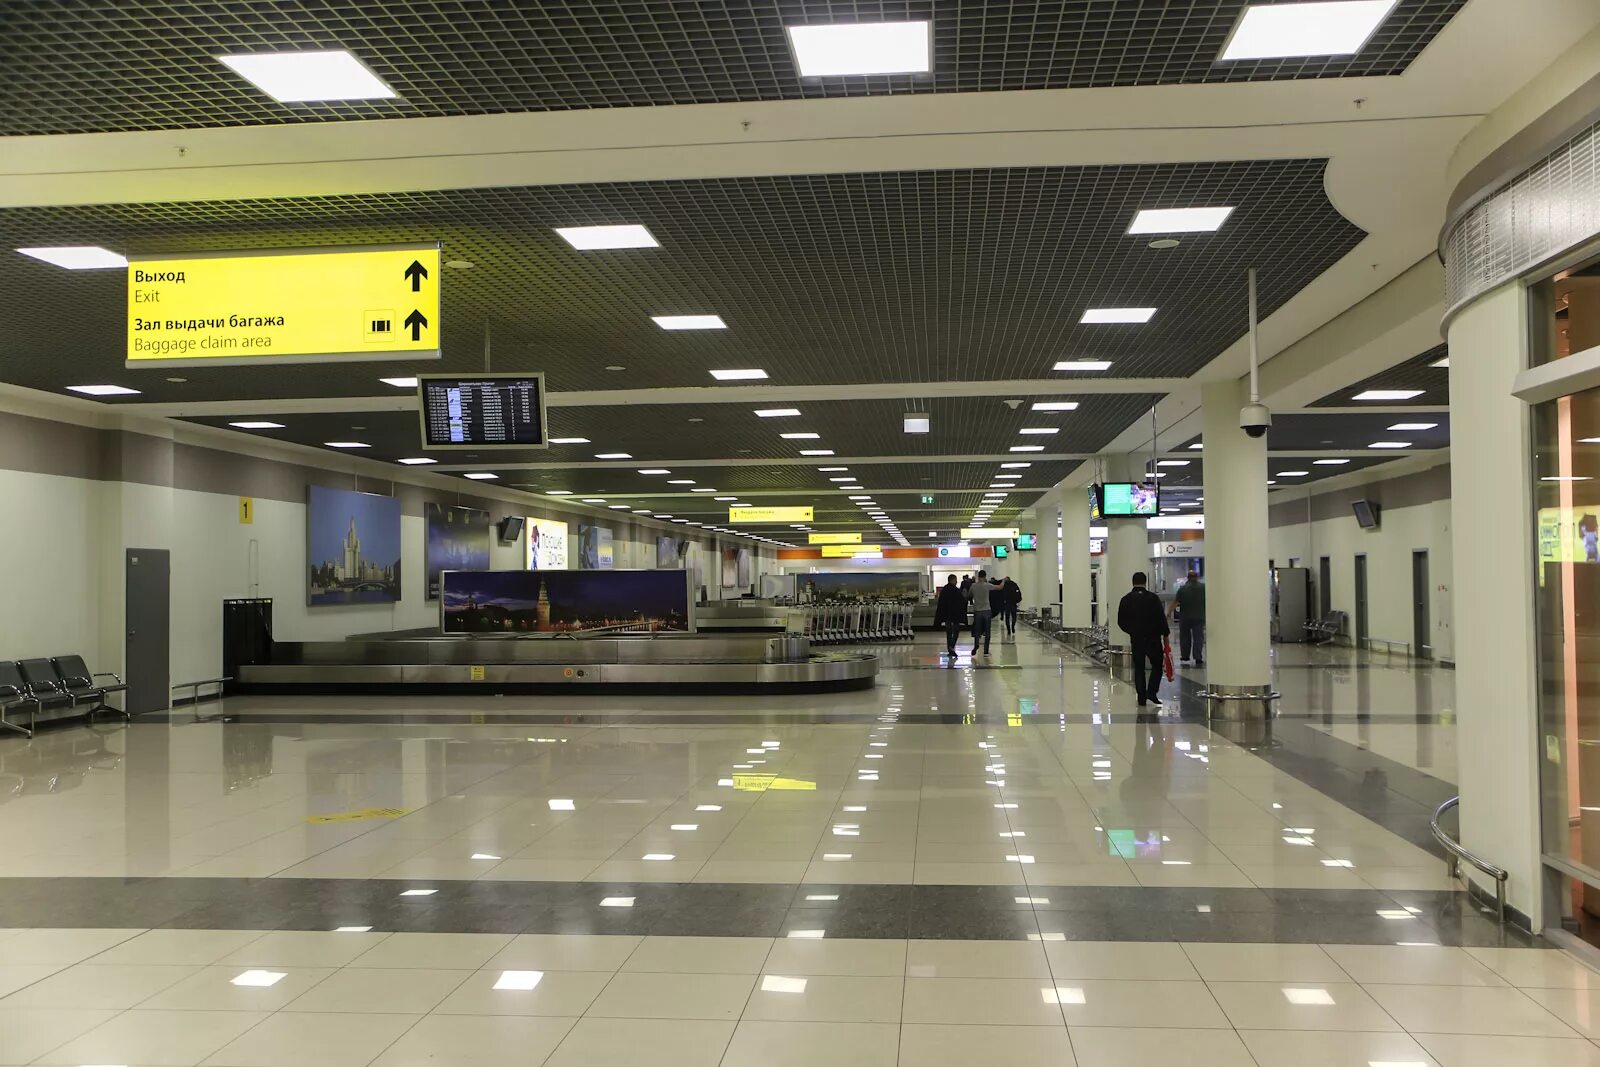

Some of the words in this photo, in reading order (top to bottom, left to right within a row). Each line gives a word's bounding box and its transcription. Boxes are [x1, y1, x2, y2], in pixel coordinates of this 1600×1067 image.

[135, 270, 186, 284] Выход
[135, 289, 160, 303] Exit
[134, 318, 161, 331] Зал
[165, 319, 225, 332] выдачи
[229, 314, 284, 328] багажа
[134, 338, 197, 355] Baggage
[200, 335, 237, 349] claim
[241, 336, 272, 348] area
[243, 501, 248, 519] 1
